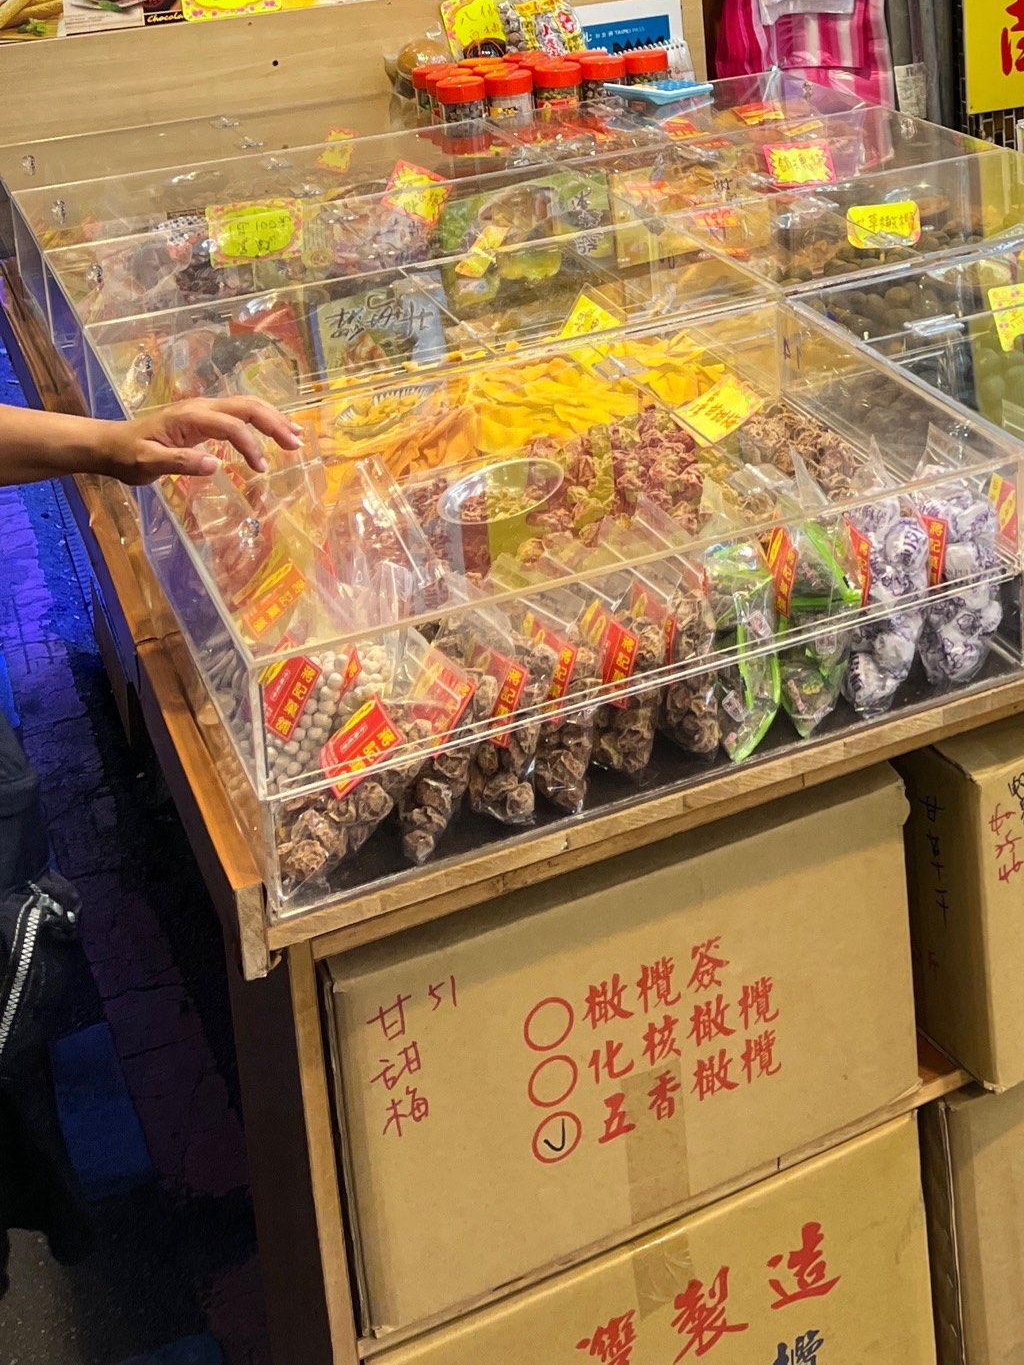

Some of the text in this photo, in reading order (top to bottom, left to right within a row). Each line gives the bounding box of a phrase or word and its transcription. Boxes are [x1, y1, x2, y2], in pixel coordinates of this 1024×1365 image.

[588, 977, 779, 1084] 化核橄欖
[598, 1030, 782, 1144] 五香橄欖
